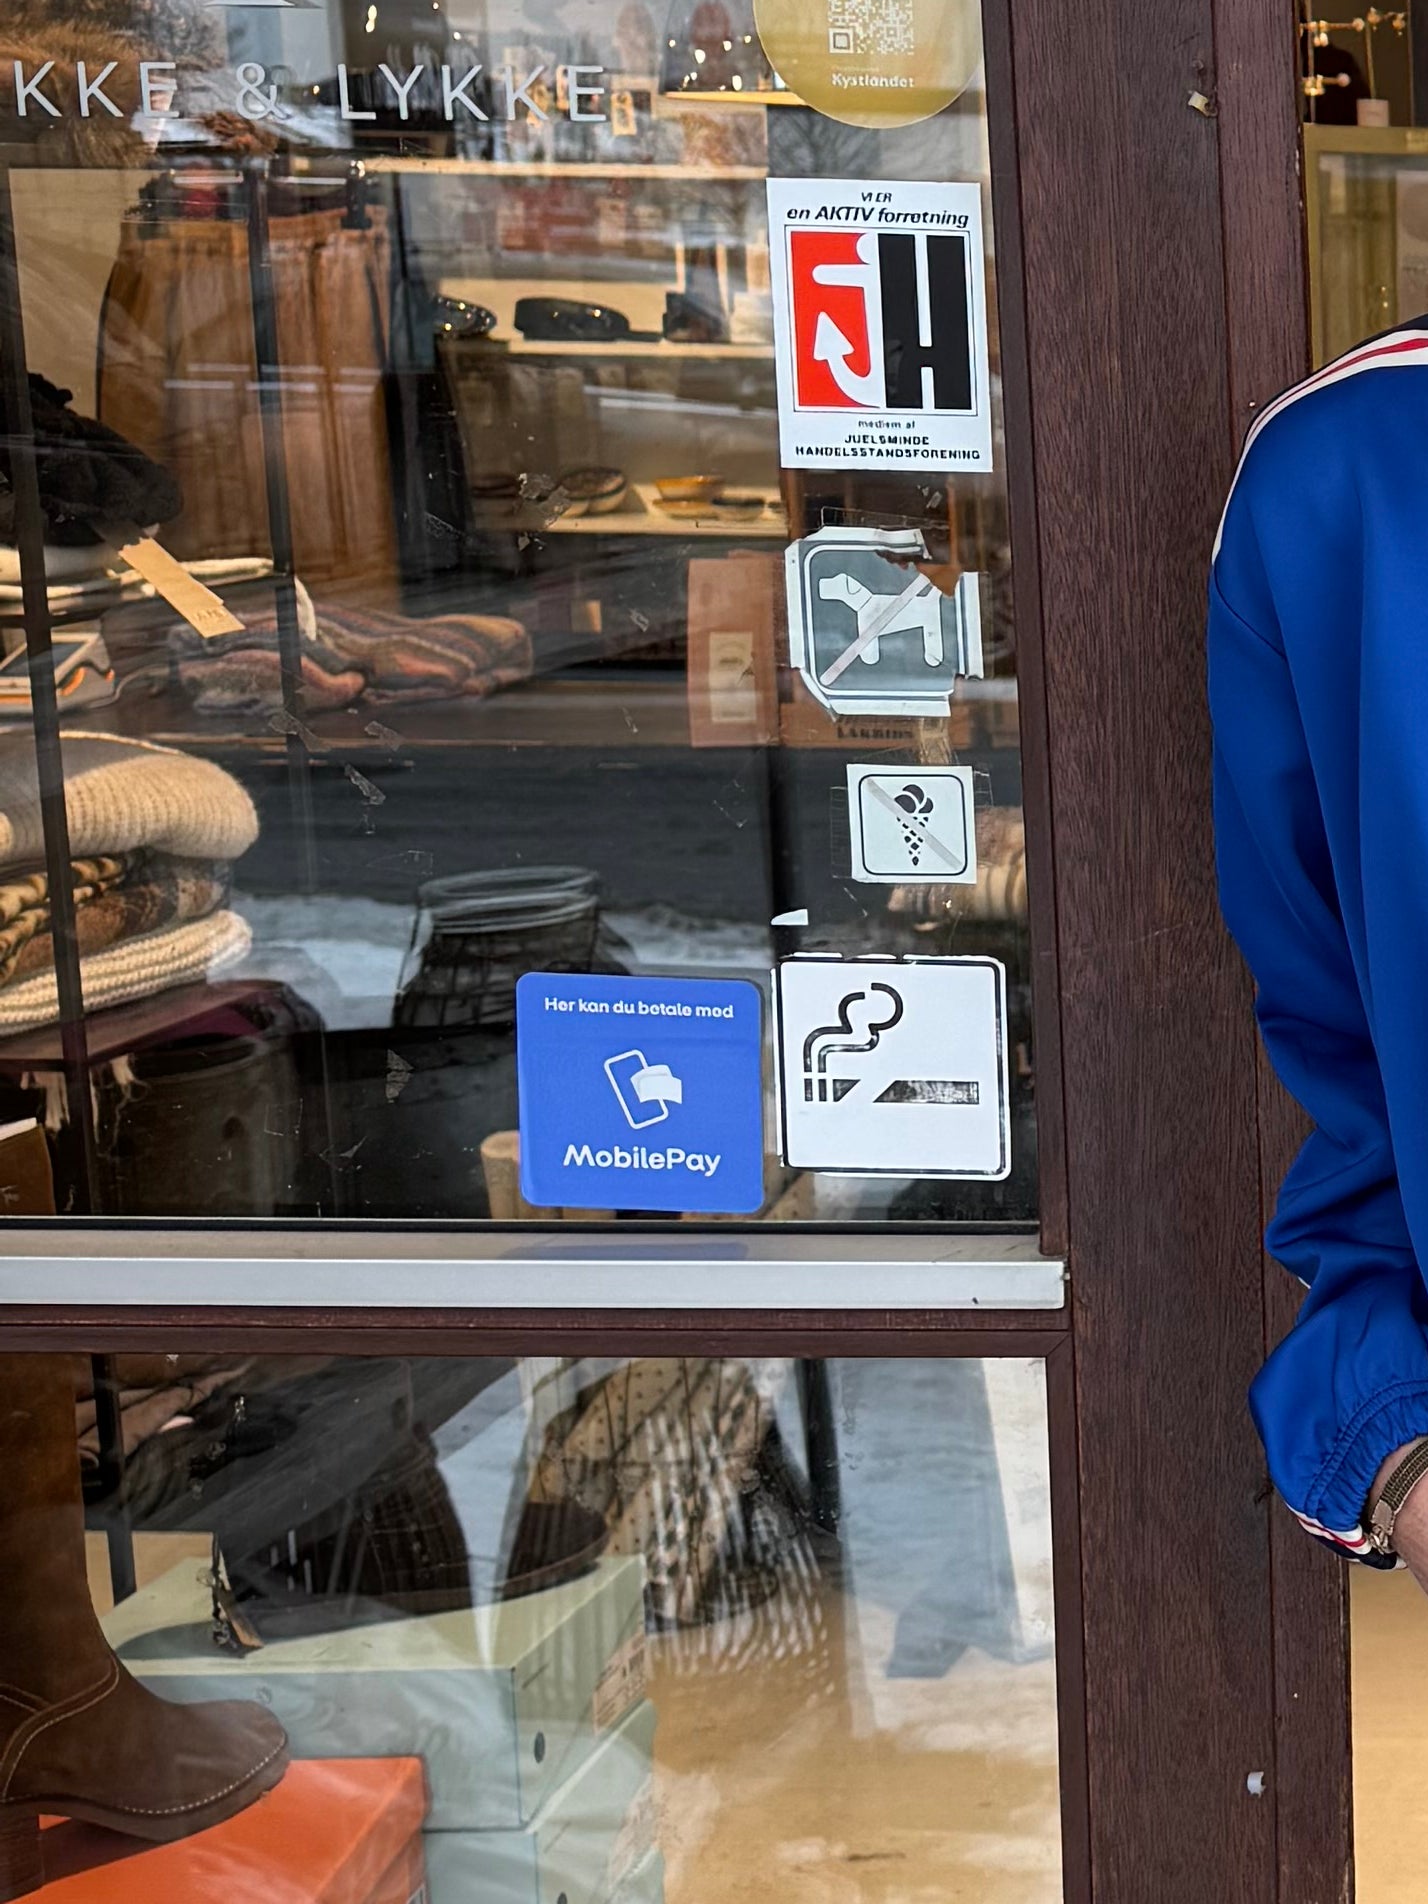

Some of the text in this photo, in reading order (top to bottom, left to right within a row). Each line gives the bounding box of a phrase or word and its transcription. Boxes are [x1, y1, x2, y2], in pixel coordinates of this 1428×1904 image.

[831, 72, 916, 89] Kystlandet
[235, 62, 281, 121] &
[336, 62, 607, 123] LYKKE
[861, 192, 893, 203] VI ER
[786, 205, 970, 229] en AKTIV forretning
[843, 433, 931, 445] JUELSMINDE
[794, 445, 982, 461] HANDELSSTANDSFORENING
[544, 996, 735, 1019] Her kan du betale med
[562, 1144, 721, 1177] MobilePay
